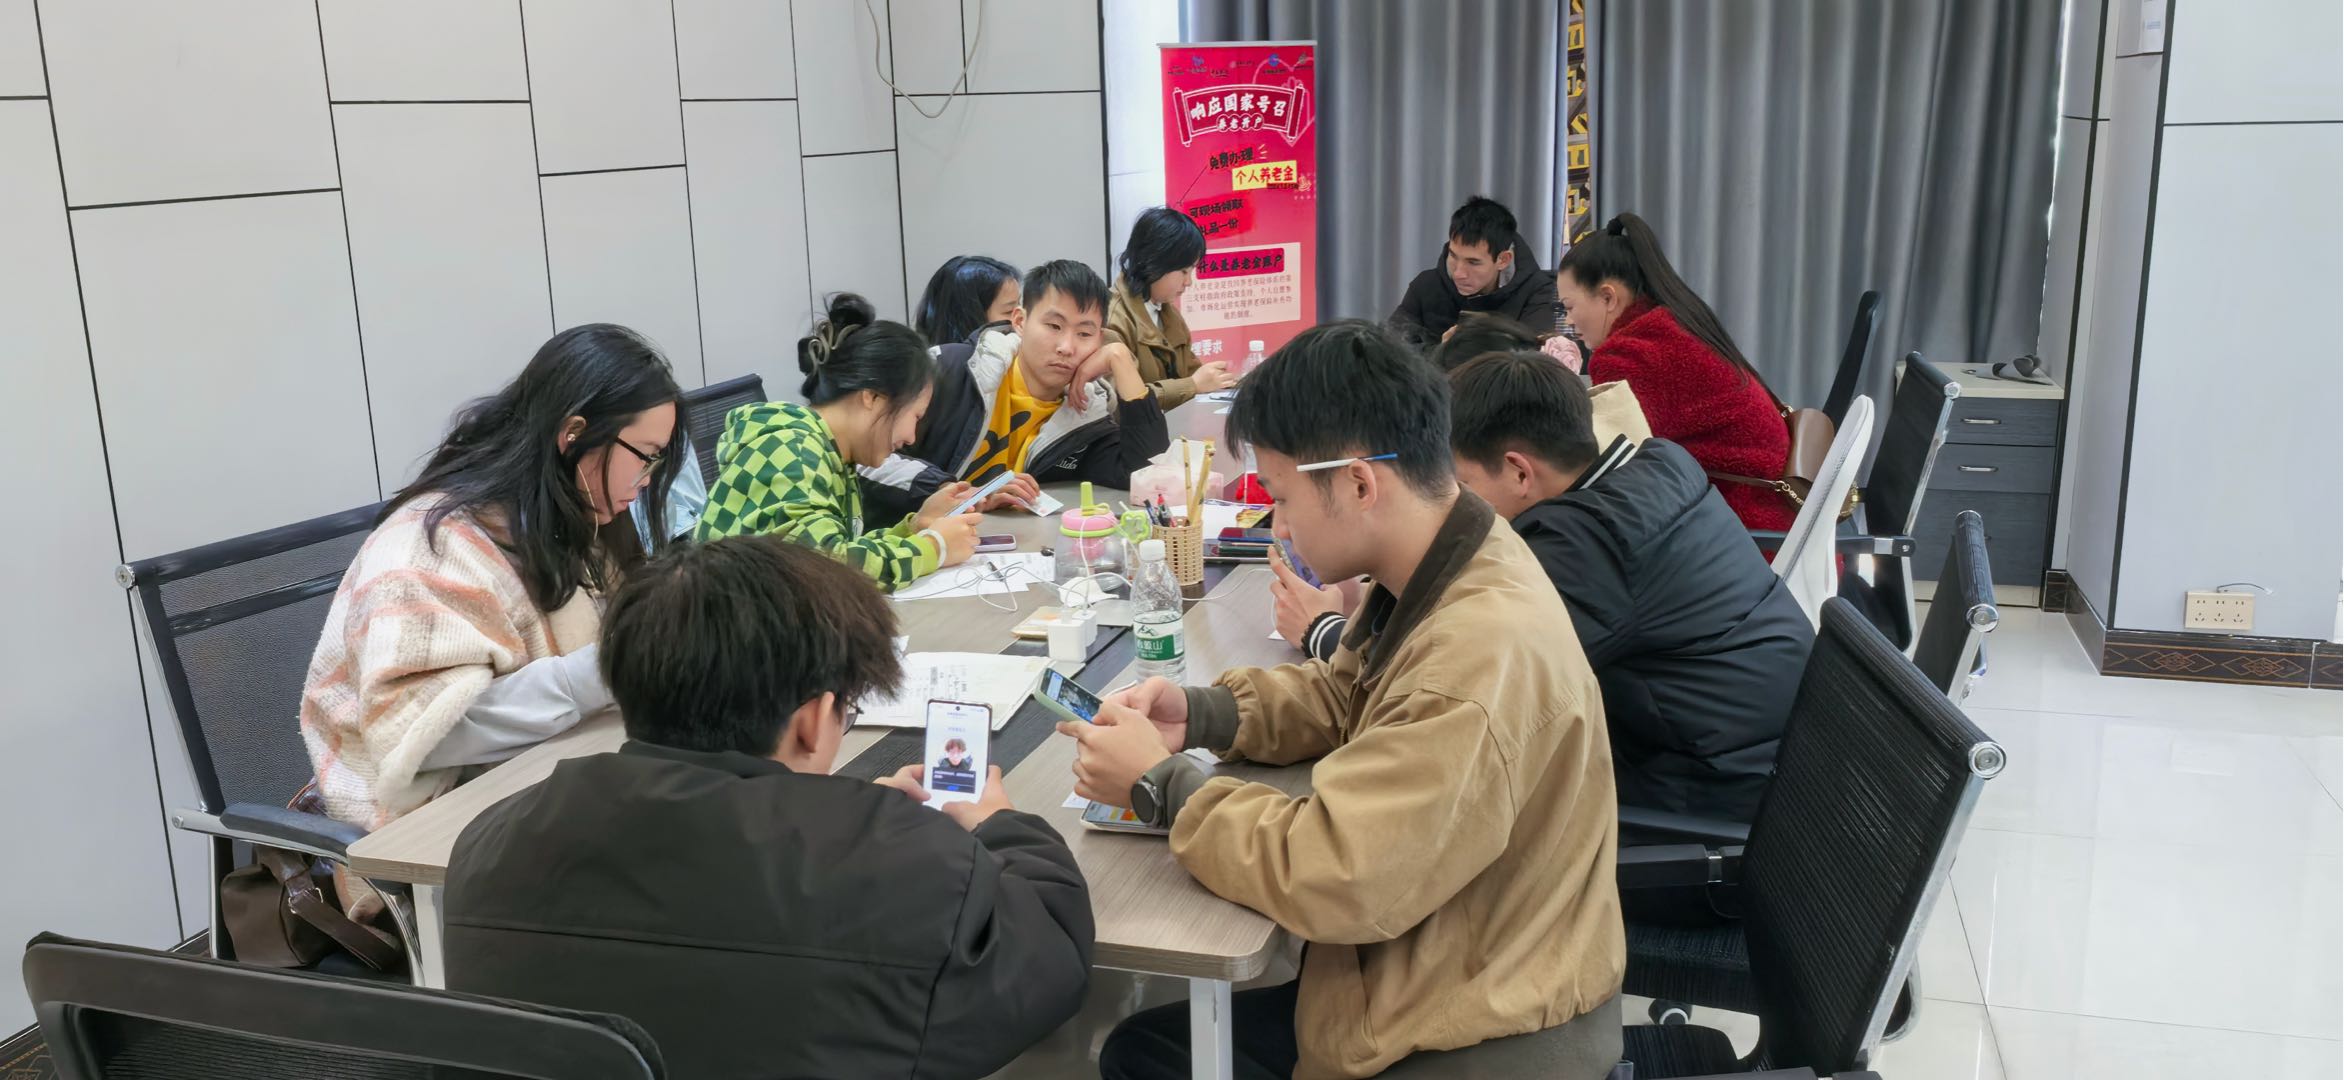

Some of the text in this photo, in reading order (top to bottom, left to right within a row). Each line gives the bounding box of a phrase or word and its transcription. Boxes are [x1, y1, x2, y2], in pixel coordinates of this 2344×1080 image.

[1190, 93, 1287, 120] 响应国家号召
[1216, 116, 1262, 130] 养老开户
[1209, 147, 1254, 170] 免费办理
[1235, 165, 1294, 185] 个人养老金
[1189, 198, 1244, 218] 可现场领取
